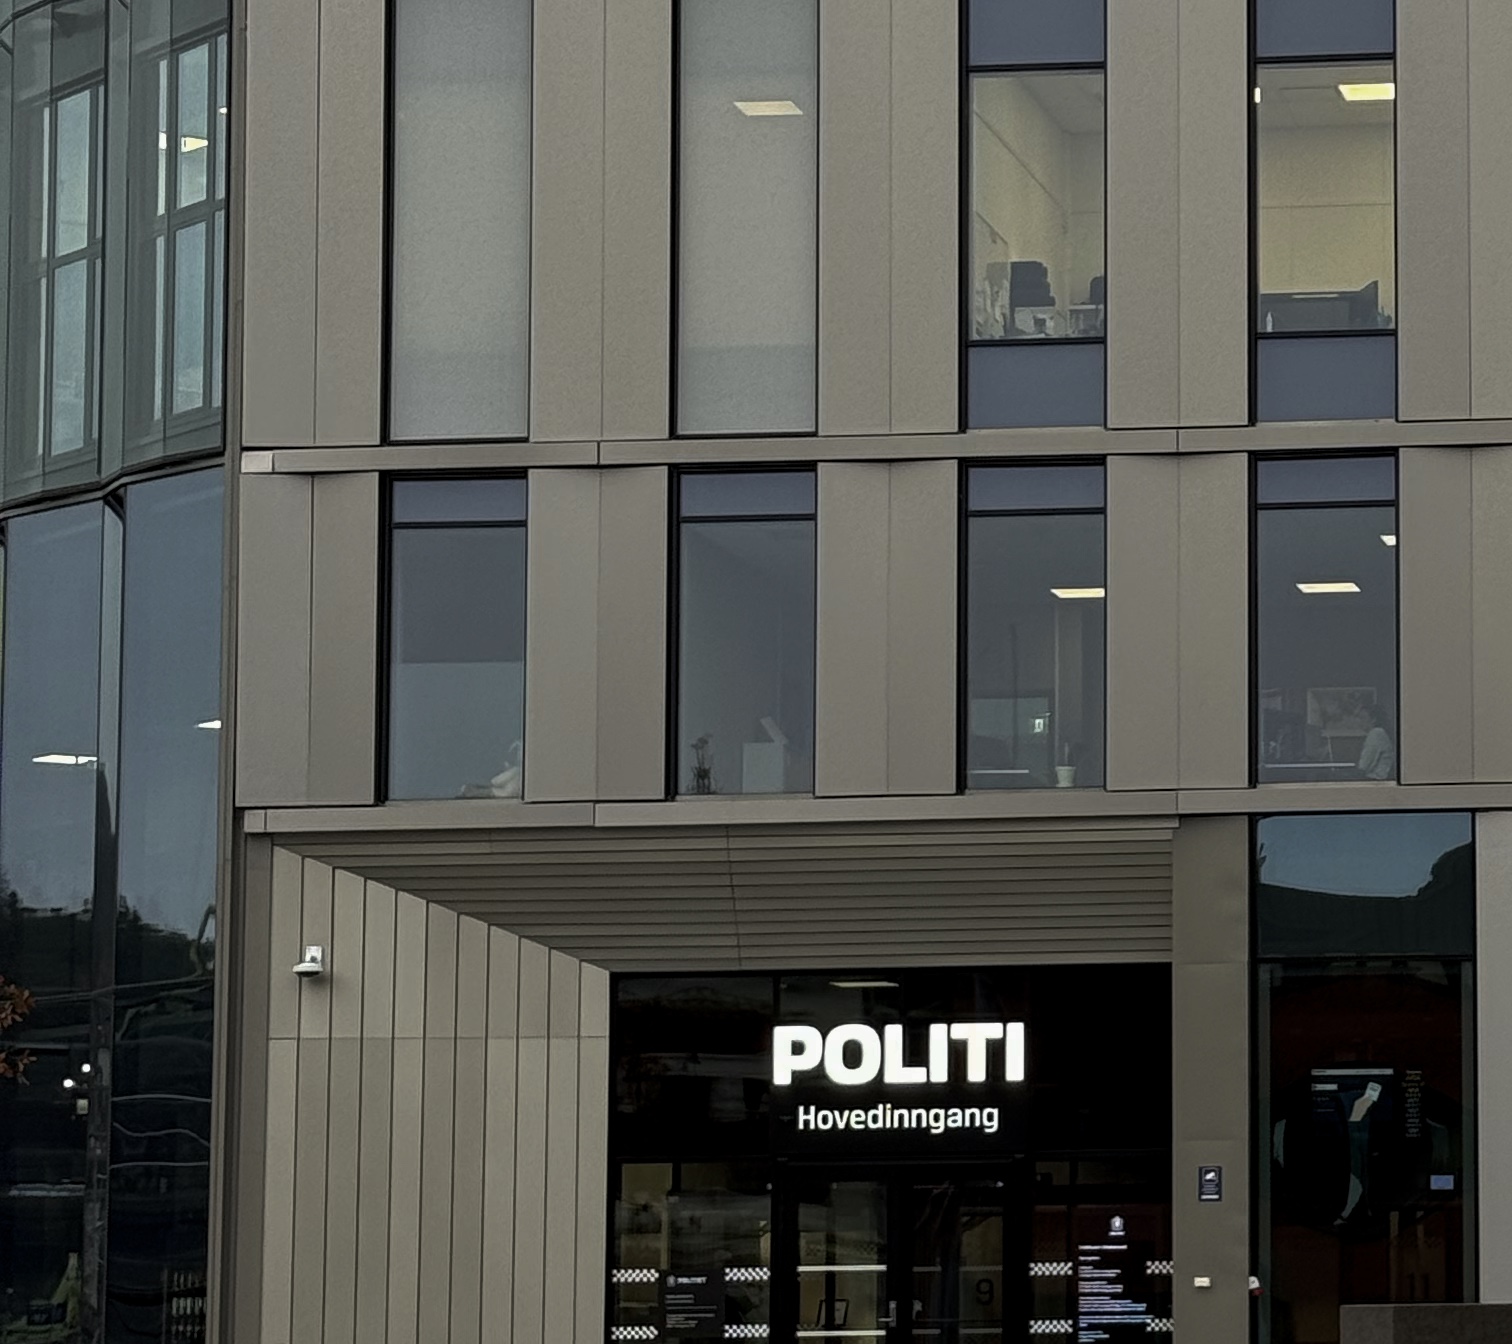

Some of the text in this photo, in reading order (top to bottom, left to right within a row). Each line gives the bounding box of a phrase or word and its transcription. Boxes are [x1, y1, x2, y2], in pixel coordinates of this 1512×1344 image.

[772, 1021, 1025, 1086] POLITI
[797, 1103, 1000, 1134] Hovedinngang
[976, 1278, 994, 1306] 9
